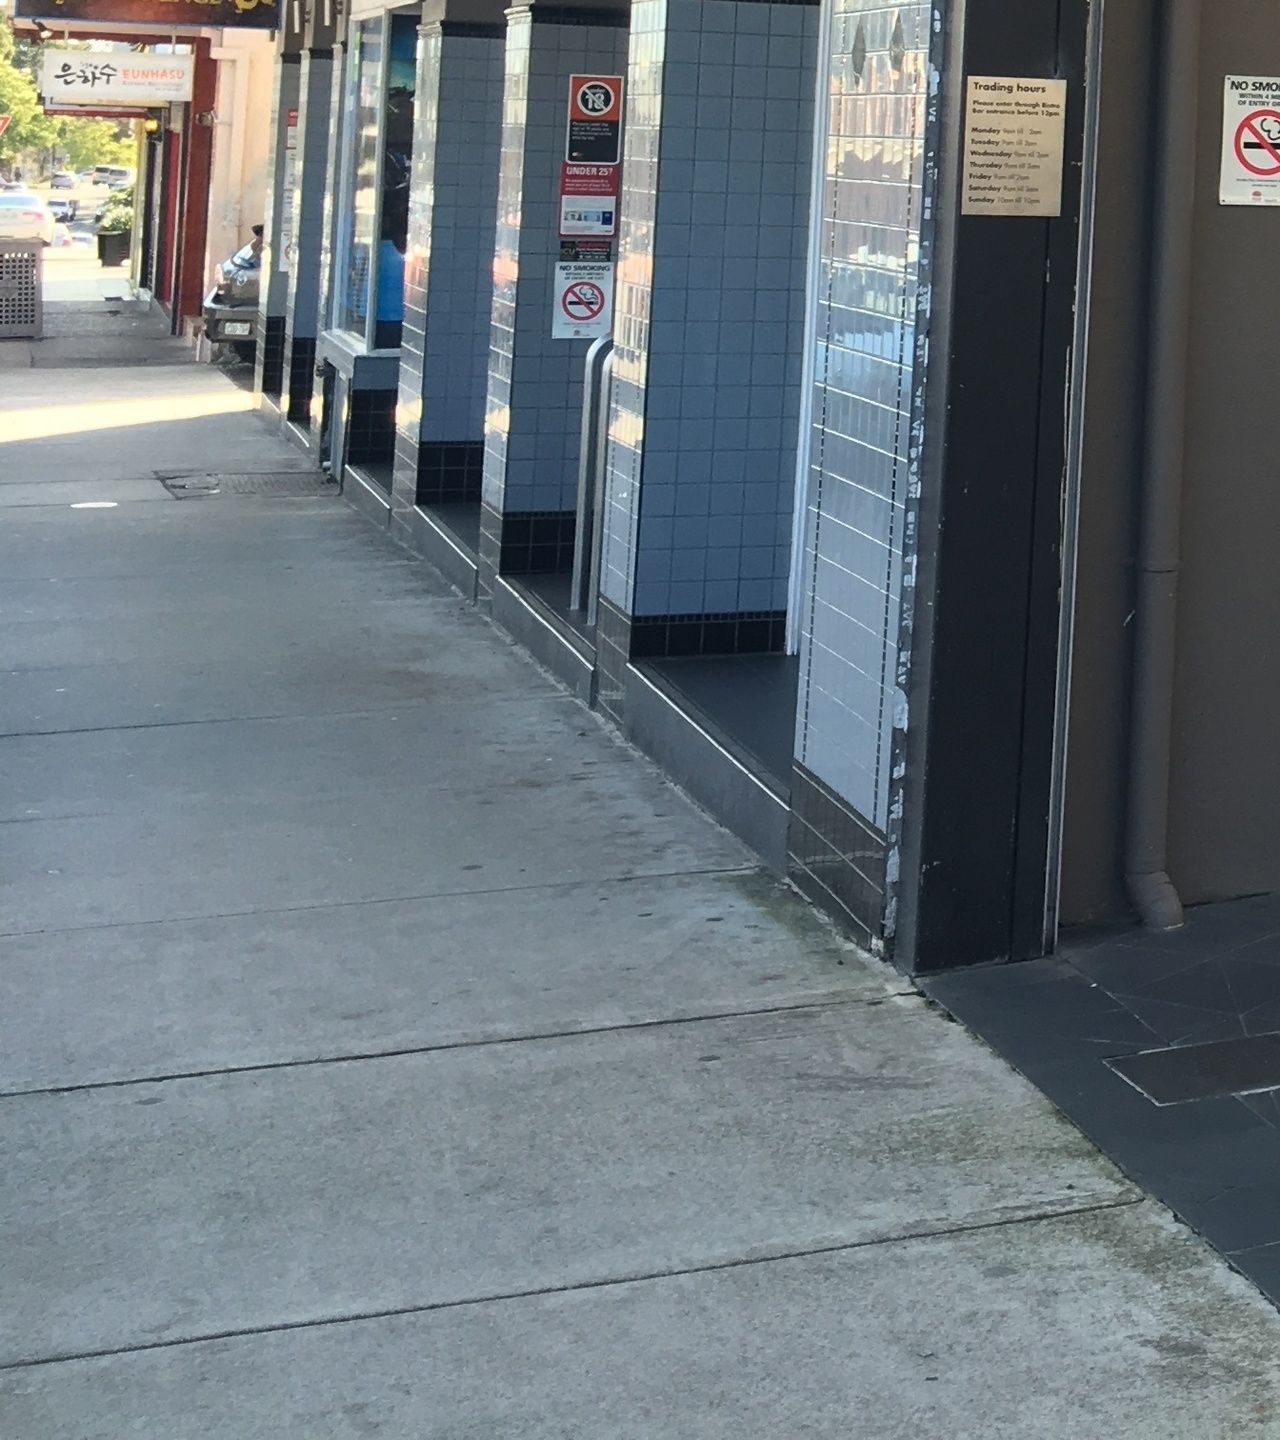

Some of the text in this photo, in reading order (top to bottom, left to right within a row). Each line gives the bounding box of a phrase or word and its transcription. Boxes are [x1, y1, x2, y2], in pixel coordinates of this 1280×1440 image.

[54, 63, 118, 87] 은하수
[121, 68, 185, 80] EUNHASU
[973, 82, 1046, 94] Trading hours
[1230, 80, 1248, 91] NO
[971, 127, 1001, 135] Monday
[971, 138, 1000, 146] Tuesday
[970, 150, 1012, 158] Wednesday
[970, 161, 1002, 169] Thursday
[566, 166, 614, 176] UNDER 25?
[968, 184, 1001, 192] Saturday
[968, 196, 995, 204] Sunday
